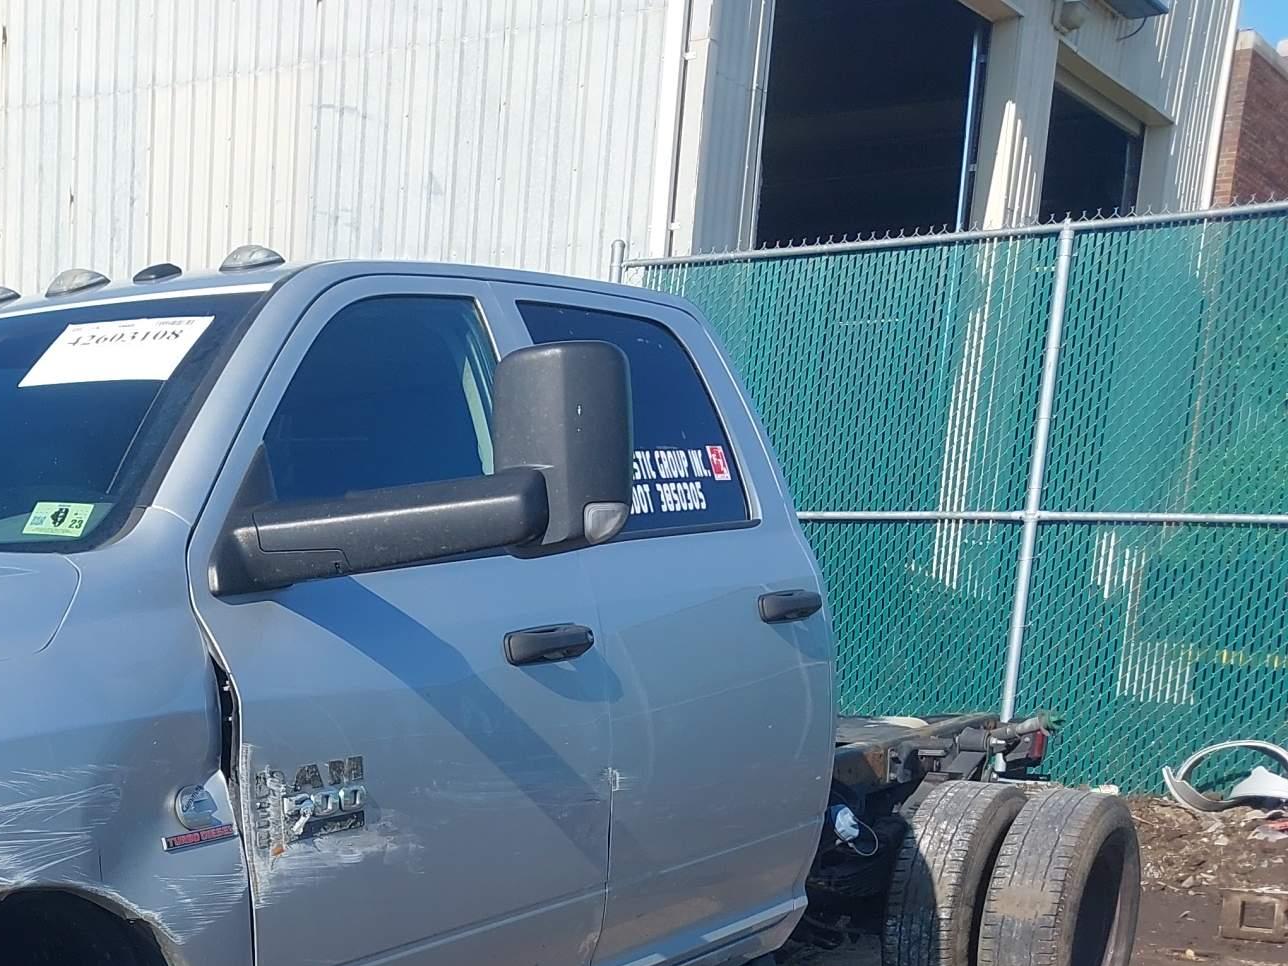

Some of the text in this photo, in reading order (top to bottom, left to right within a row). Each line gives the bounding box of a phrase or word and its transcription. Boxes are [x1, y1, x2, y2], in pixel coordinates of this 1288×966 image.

[68, 328, 184, 347] 42603108
[632, 451, 657, 480] STIC
[654, 450, 689, 479] GROUP
[631, 481, 707, 515] DOT 3850305
[68, 518, 84, 529] 23
